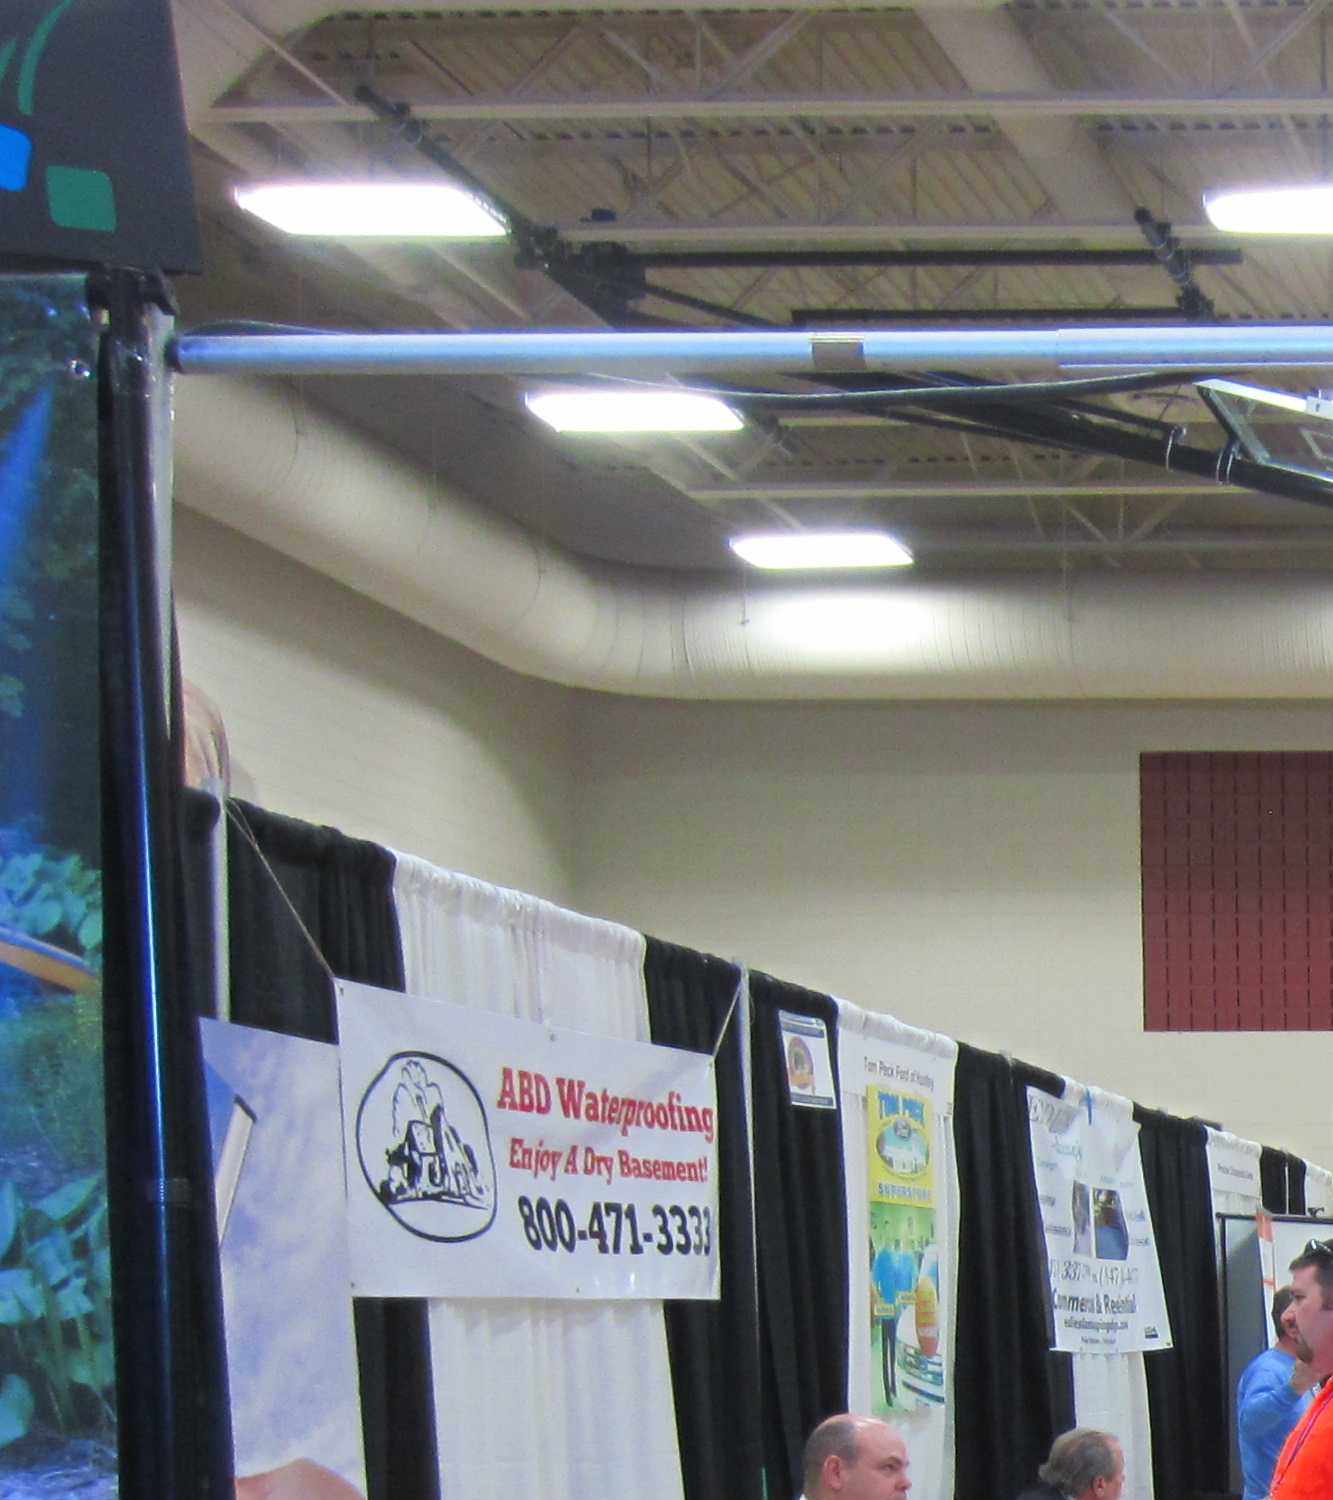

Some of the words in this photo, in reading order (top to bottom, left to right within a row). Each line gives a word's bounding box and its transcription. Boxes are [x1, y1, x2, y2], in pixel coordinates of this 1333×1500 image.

[496, 1067, 551, 1115] ABD
[556, 1077, 714, 1143] Waterproofing
[510, 1137, 562, 1181] Enjoy
[564, 1145, 578, 1174] A
[584, 1146, 613, 1185] Dry
[618, 1150, 708, 1182] Basement!
[518, 1195, 711, 1256] 800-471-3333
